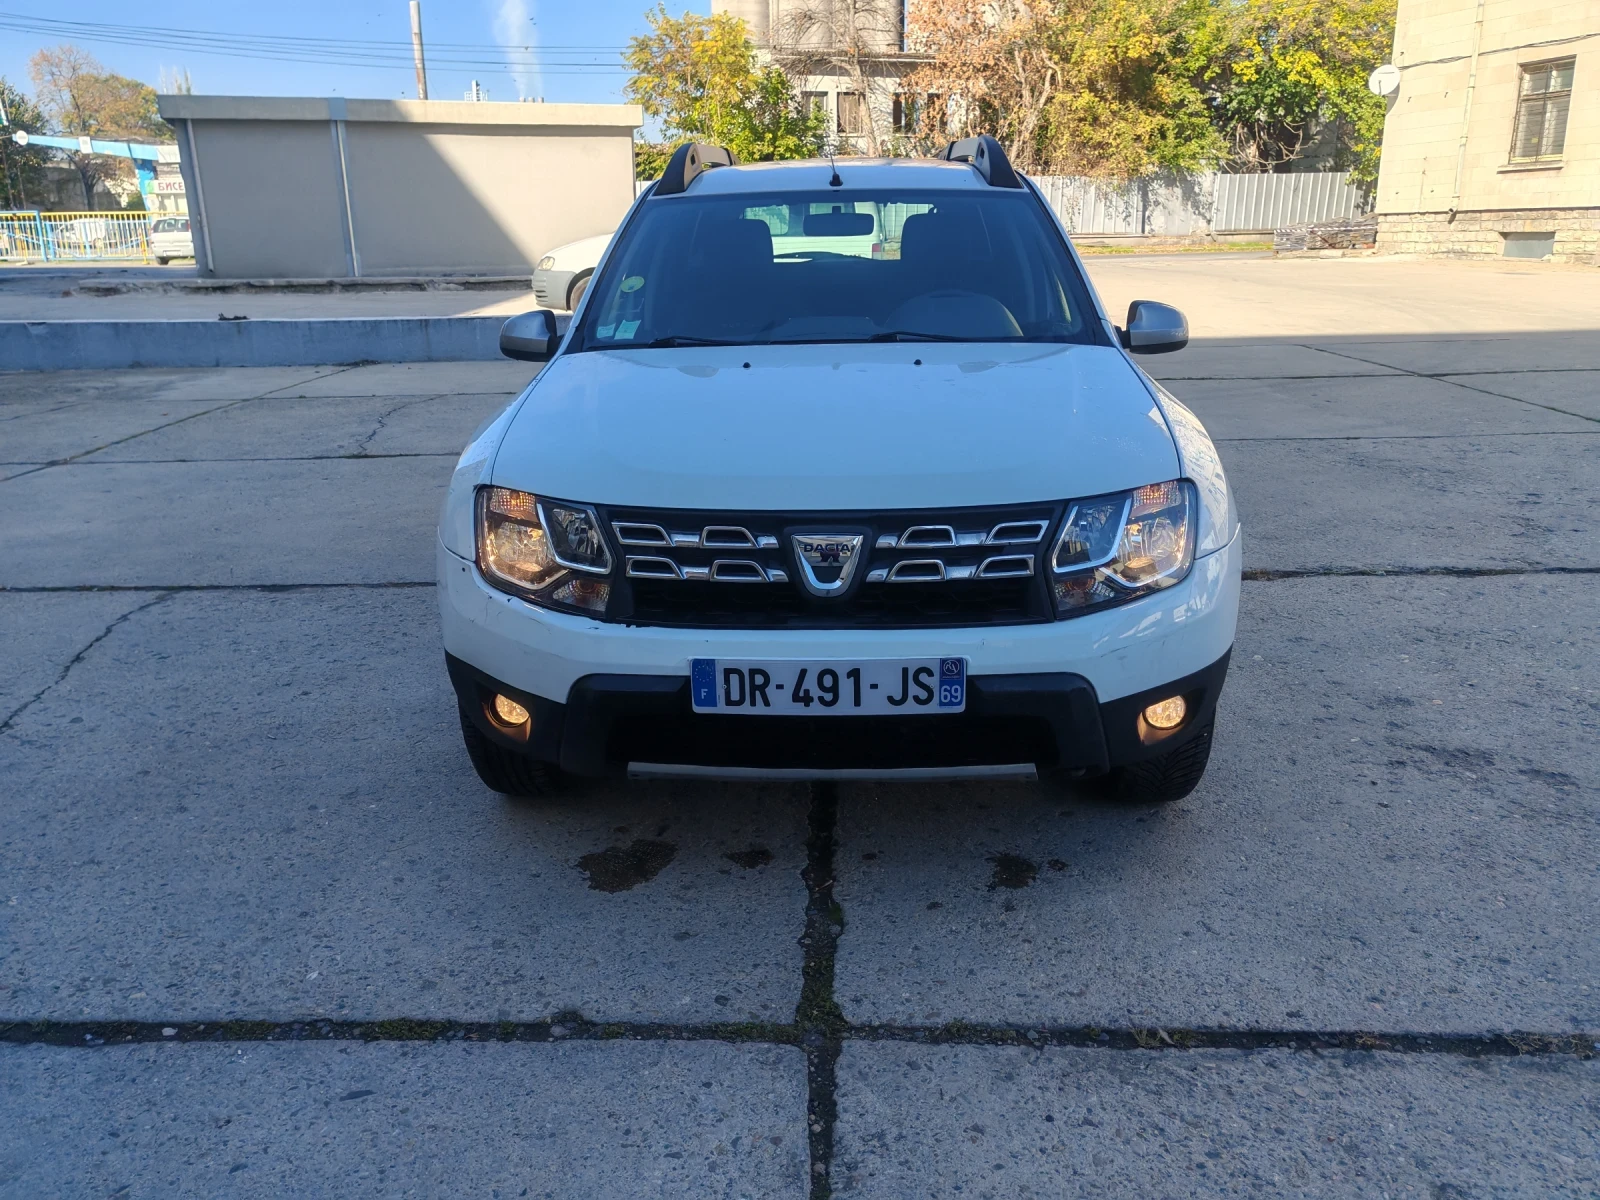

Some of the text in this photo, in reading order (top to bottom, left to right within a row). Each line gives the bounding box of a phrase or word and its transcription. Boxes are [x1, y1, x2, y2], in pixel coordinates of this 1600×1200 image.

[803, 543, 851, 553] DACIA
[701, 688, 709, 699] F
[723, 667, 935, 708] DR-491-JS
[940, 685, 962, 703] 69
